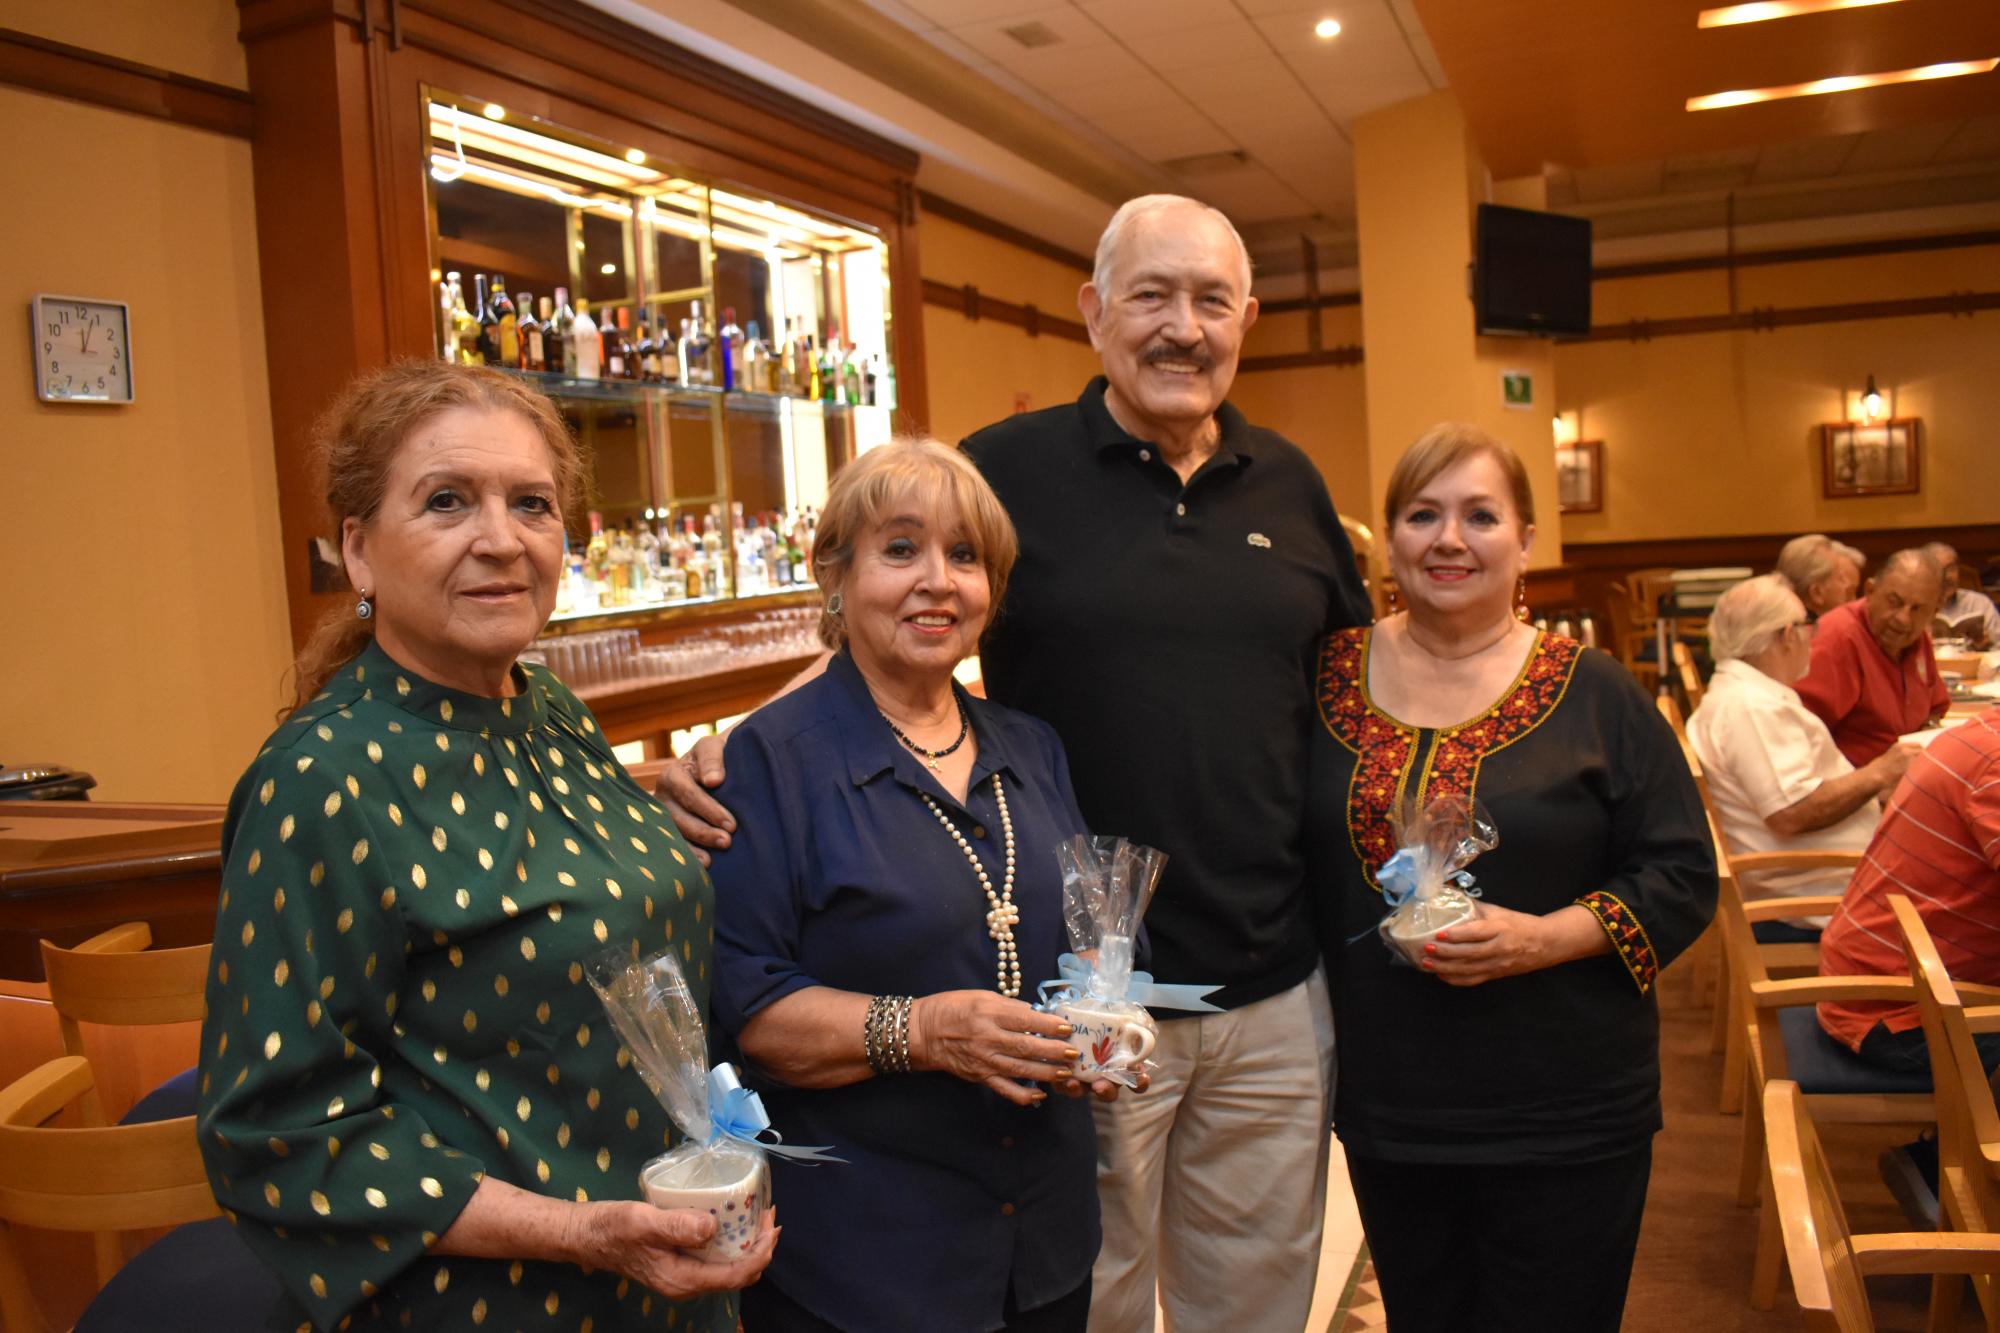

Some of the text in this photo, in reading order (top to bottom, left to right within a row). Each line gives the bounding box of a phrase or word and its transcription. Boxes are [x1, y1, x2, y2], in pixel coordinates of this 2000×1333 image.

[59, 311, 69, 325] 11
[75, 305, 88, 320] 12
[95, 314, 100, 327] 1
[48, 323, 61, 337] 10
[106, 328, 114, 341] 2
[44, 342, 52, 354] 9
[113, 347, 120, 360] 3
[51, 361, 59, 374] 8
[109, 364, 116, 376] 4
[66, 375, 72, 387] 7
[97, 377, 105, 390] 5
[82, 382, 90, 394] 6
